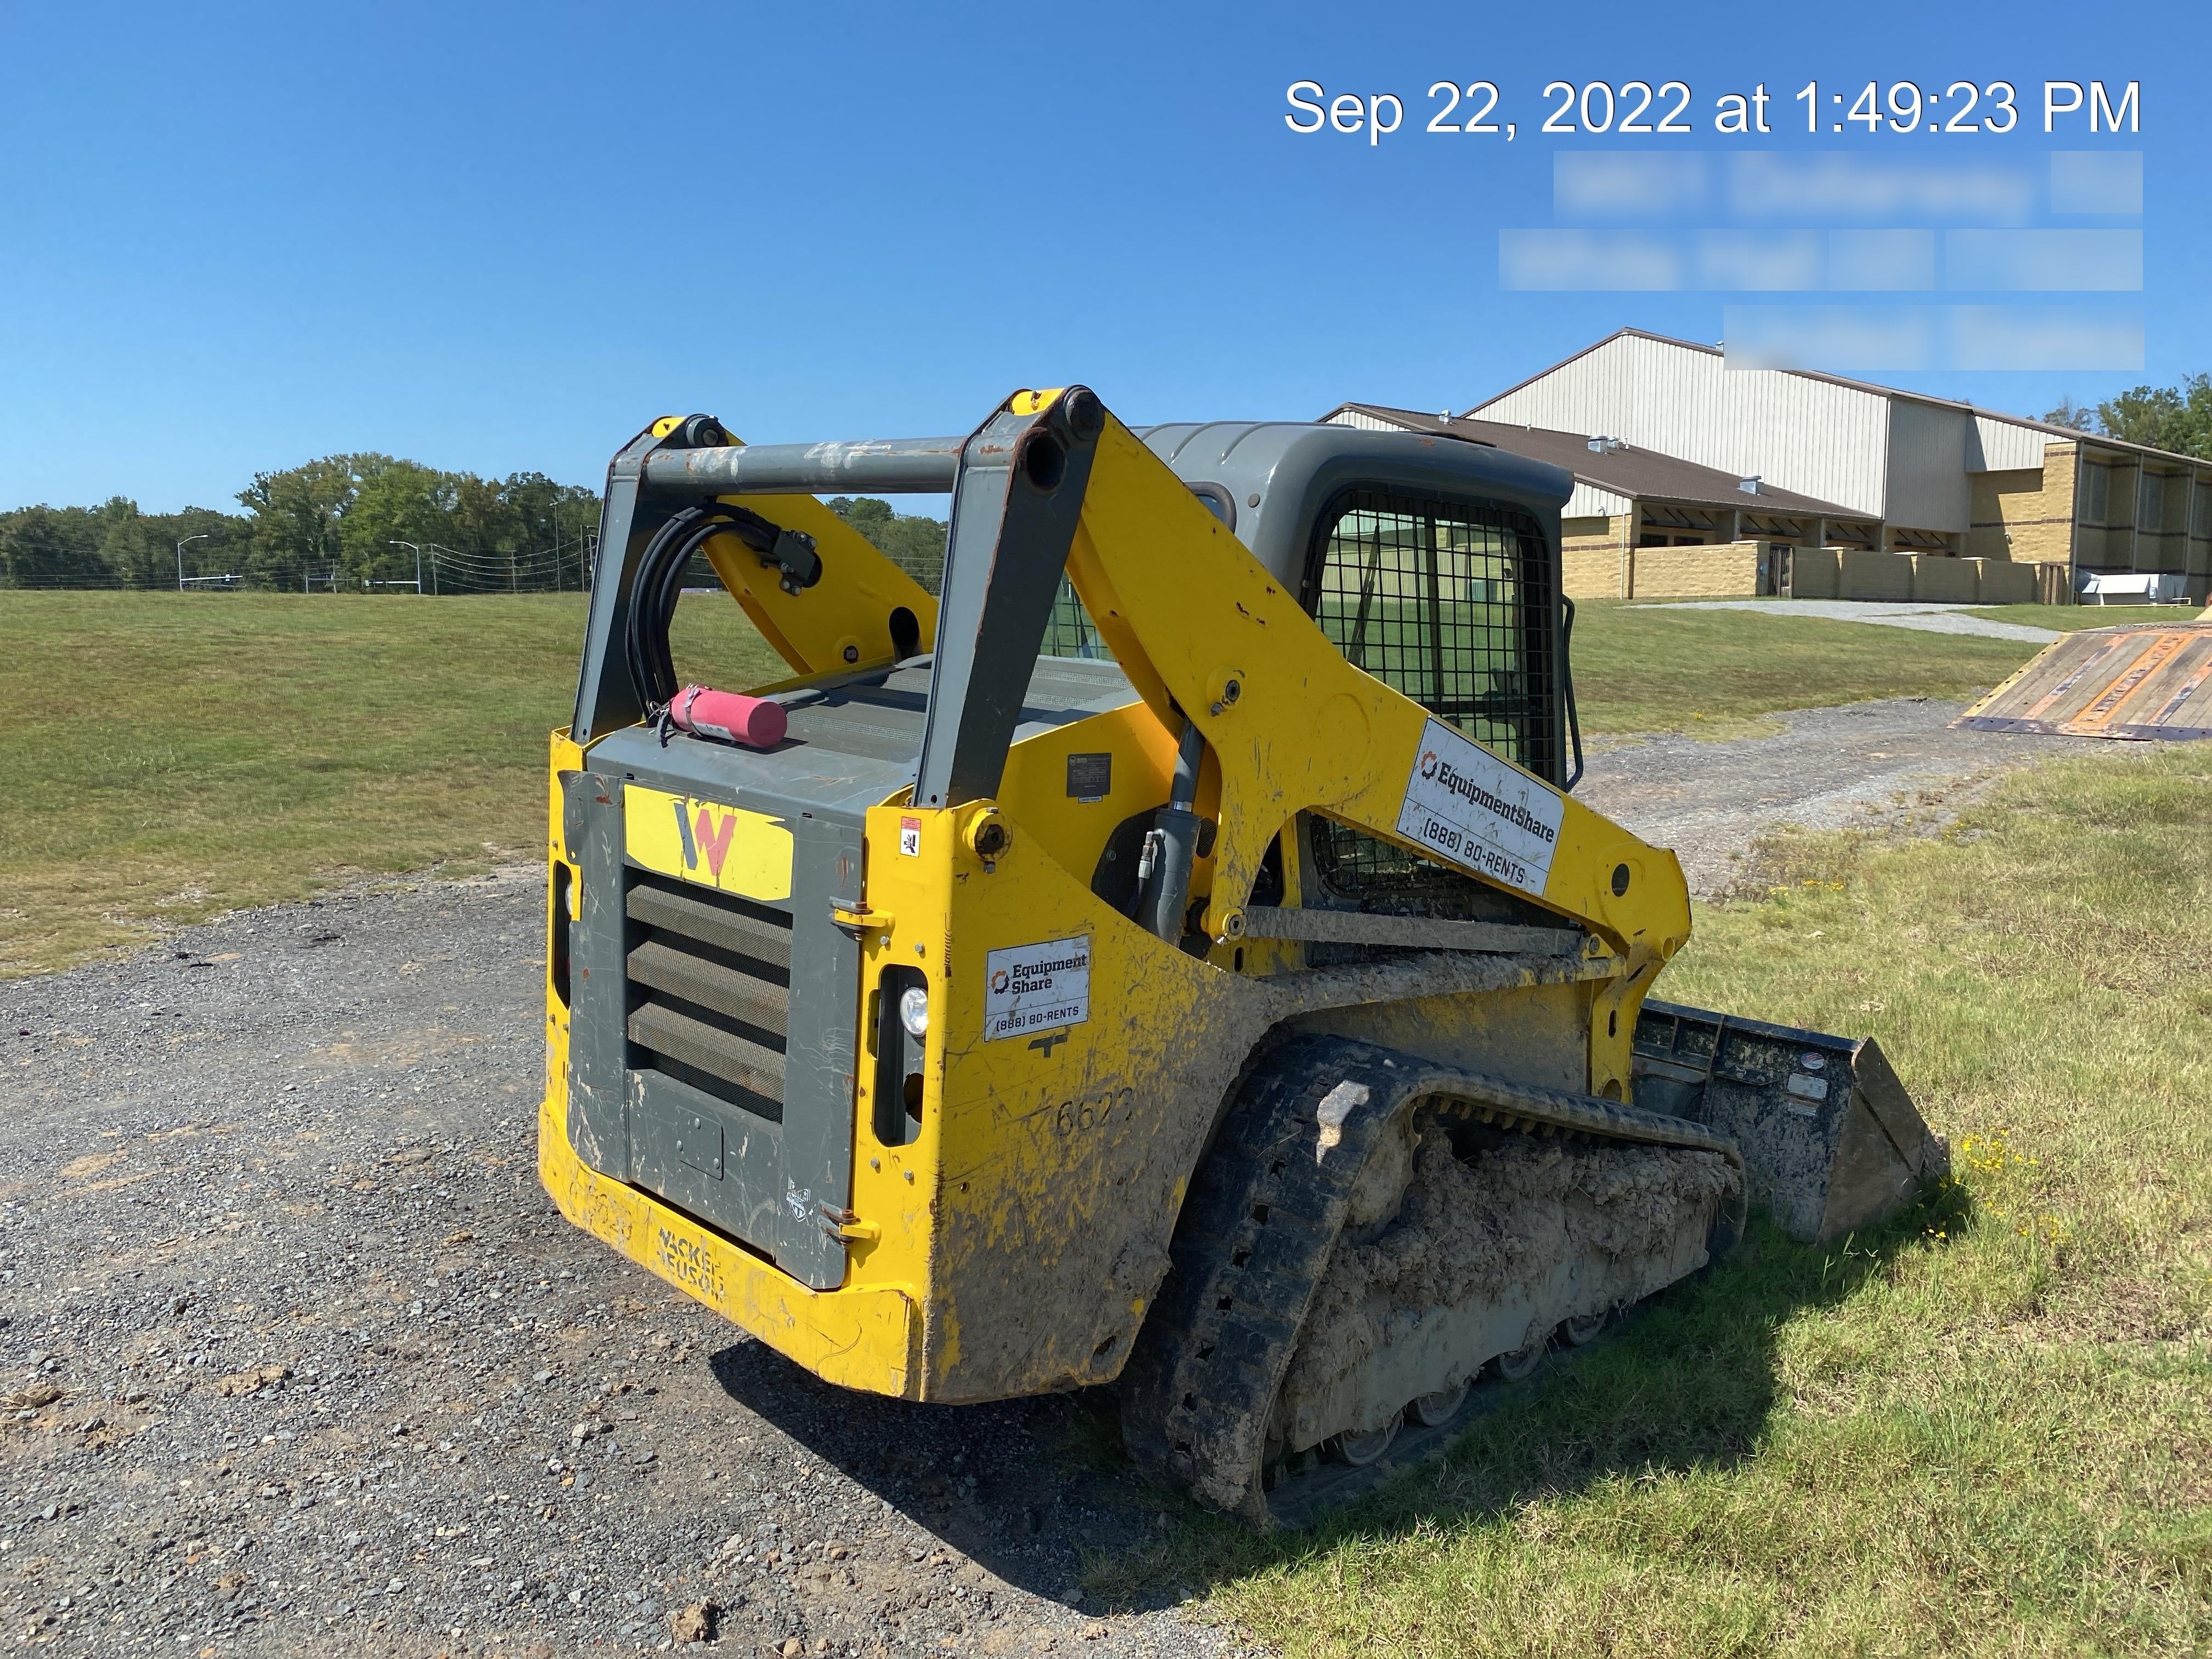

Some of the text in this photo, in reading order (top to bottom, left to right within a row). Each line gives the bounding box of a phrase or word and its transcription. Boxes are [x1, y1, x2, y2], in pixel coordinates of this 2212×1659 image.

[1437, 761, 1554, 843] EquipmentShare
[1423, 817, 1525, 884] (888) 80-RENTS
[1012, 954, 1087, 979] Equipment
[1012, 978, 1052, 995] Share
[996, 1006, 1079, 1032] (888) 80-RENTS
